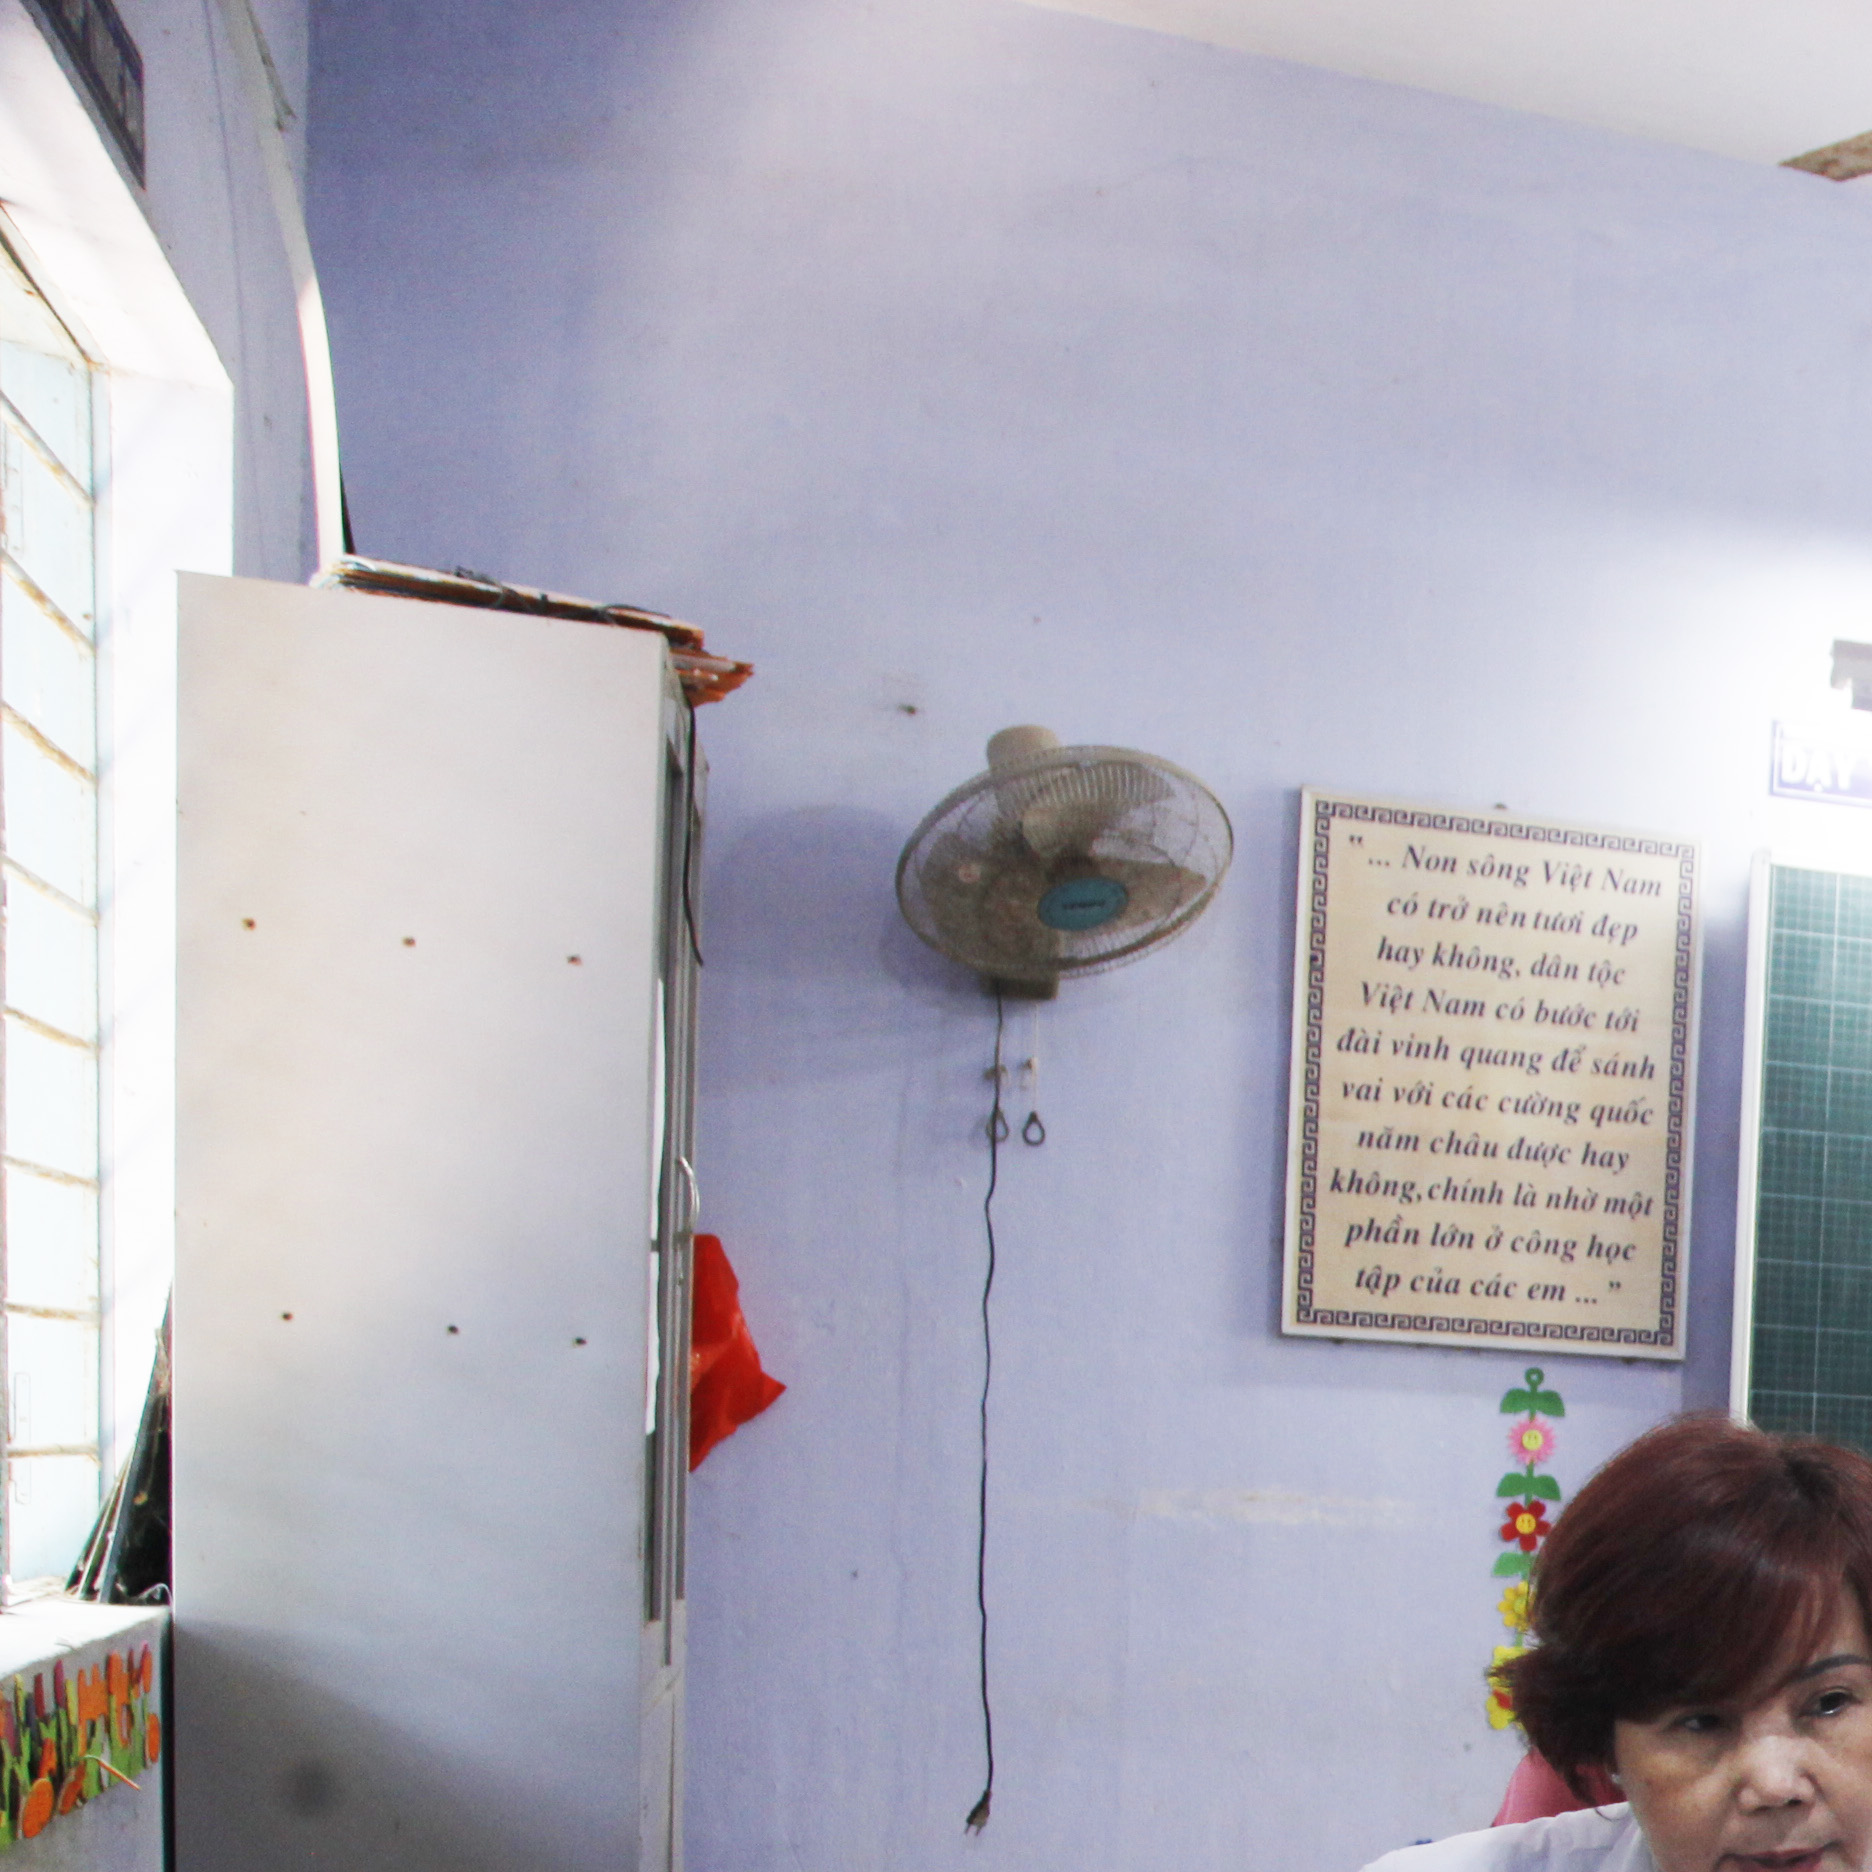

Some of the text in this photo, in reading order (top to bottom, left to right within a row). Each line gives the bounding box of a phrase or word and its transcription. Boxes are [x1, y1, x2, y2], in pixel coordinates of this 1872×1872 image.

[1402, 845, 1458, 876] Non
[1468, 859, 1530, 887] sông
[1542, 861, 1592, 891] Việt
[1602, 868, 1662, 898] Nam
[1387, 894, 1638, 946] có trở nên tươi đẹp
[1377, 936, 1626, 988] hay không, dân tộc
[1361, 981, 1640, 1032] Việt Nam có bước tới
[1336, 1027, 1656, 1081] đài vinh quang để sánh
[1342, 1077, 1654, 1128] vai với các cường quốc
[1357, 1129, 1629, 1175] năm châu được hay
[1513, 1182, 1537, 1208] là
[1545, 1186, 1599, 1212] nhờ
[1603, 1192, 1653, 1220] một
[1344, 1216, 1636, 1265] phần lớn ở công học
[1355, 1265, 1401, 1298] tập
[1409, 1268, 1461, 1295] của
[1469, 1272, 1517, 1299] các
[1527, 1282, 1566, 1302] em
